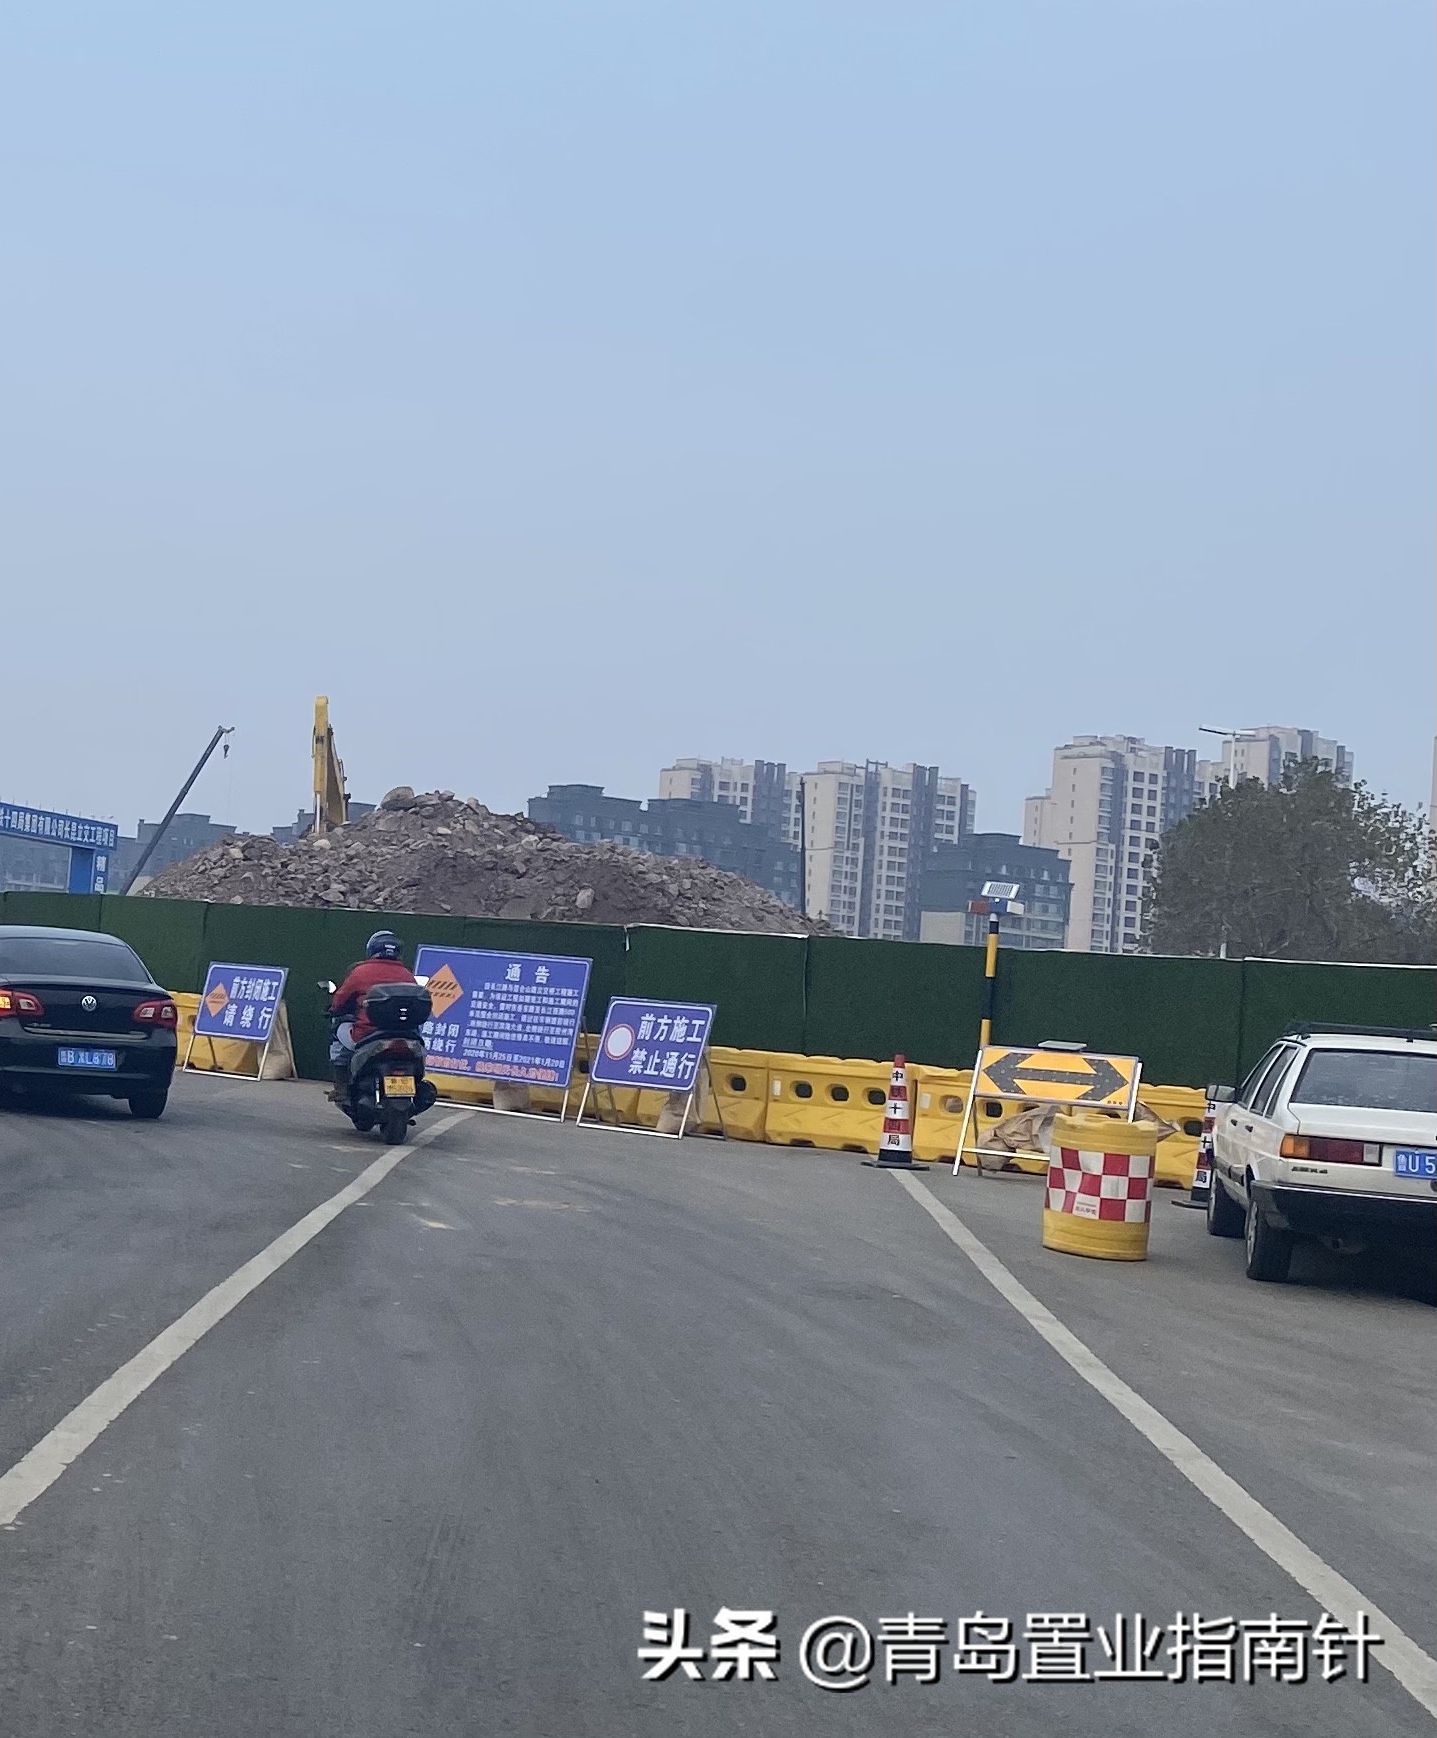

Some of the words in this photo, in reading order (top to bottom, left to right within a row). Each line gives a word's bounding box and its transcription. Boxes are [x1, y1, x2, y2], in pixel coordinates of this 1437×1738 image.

[504, 962, 551, 984] 通告
[229, 975, 279, 1001] 前方封闭施工
[223, 1003, 273, 1030] 请绕行
[637, 1013, 706, 1043] 前方施工
[628, 1048, 696, 1079] 禁止通行
